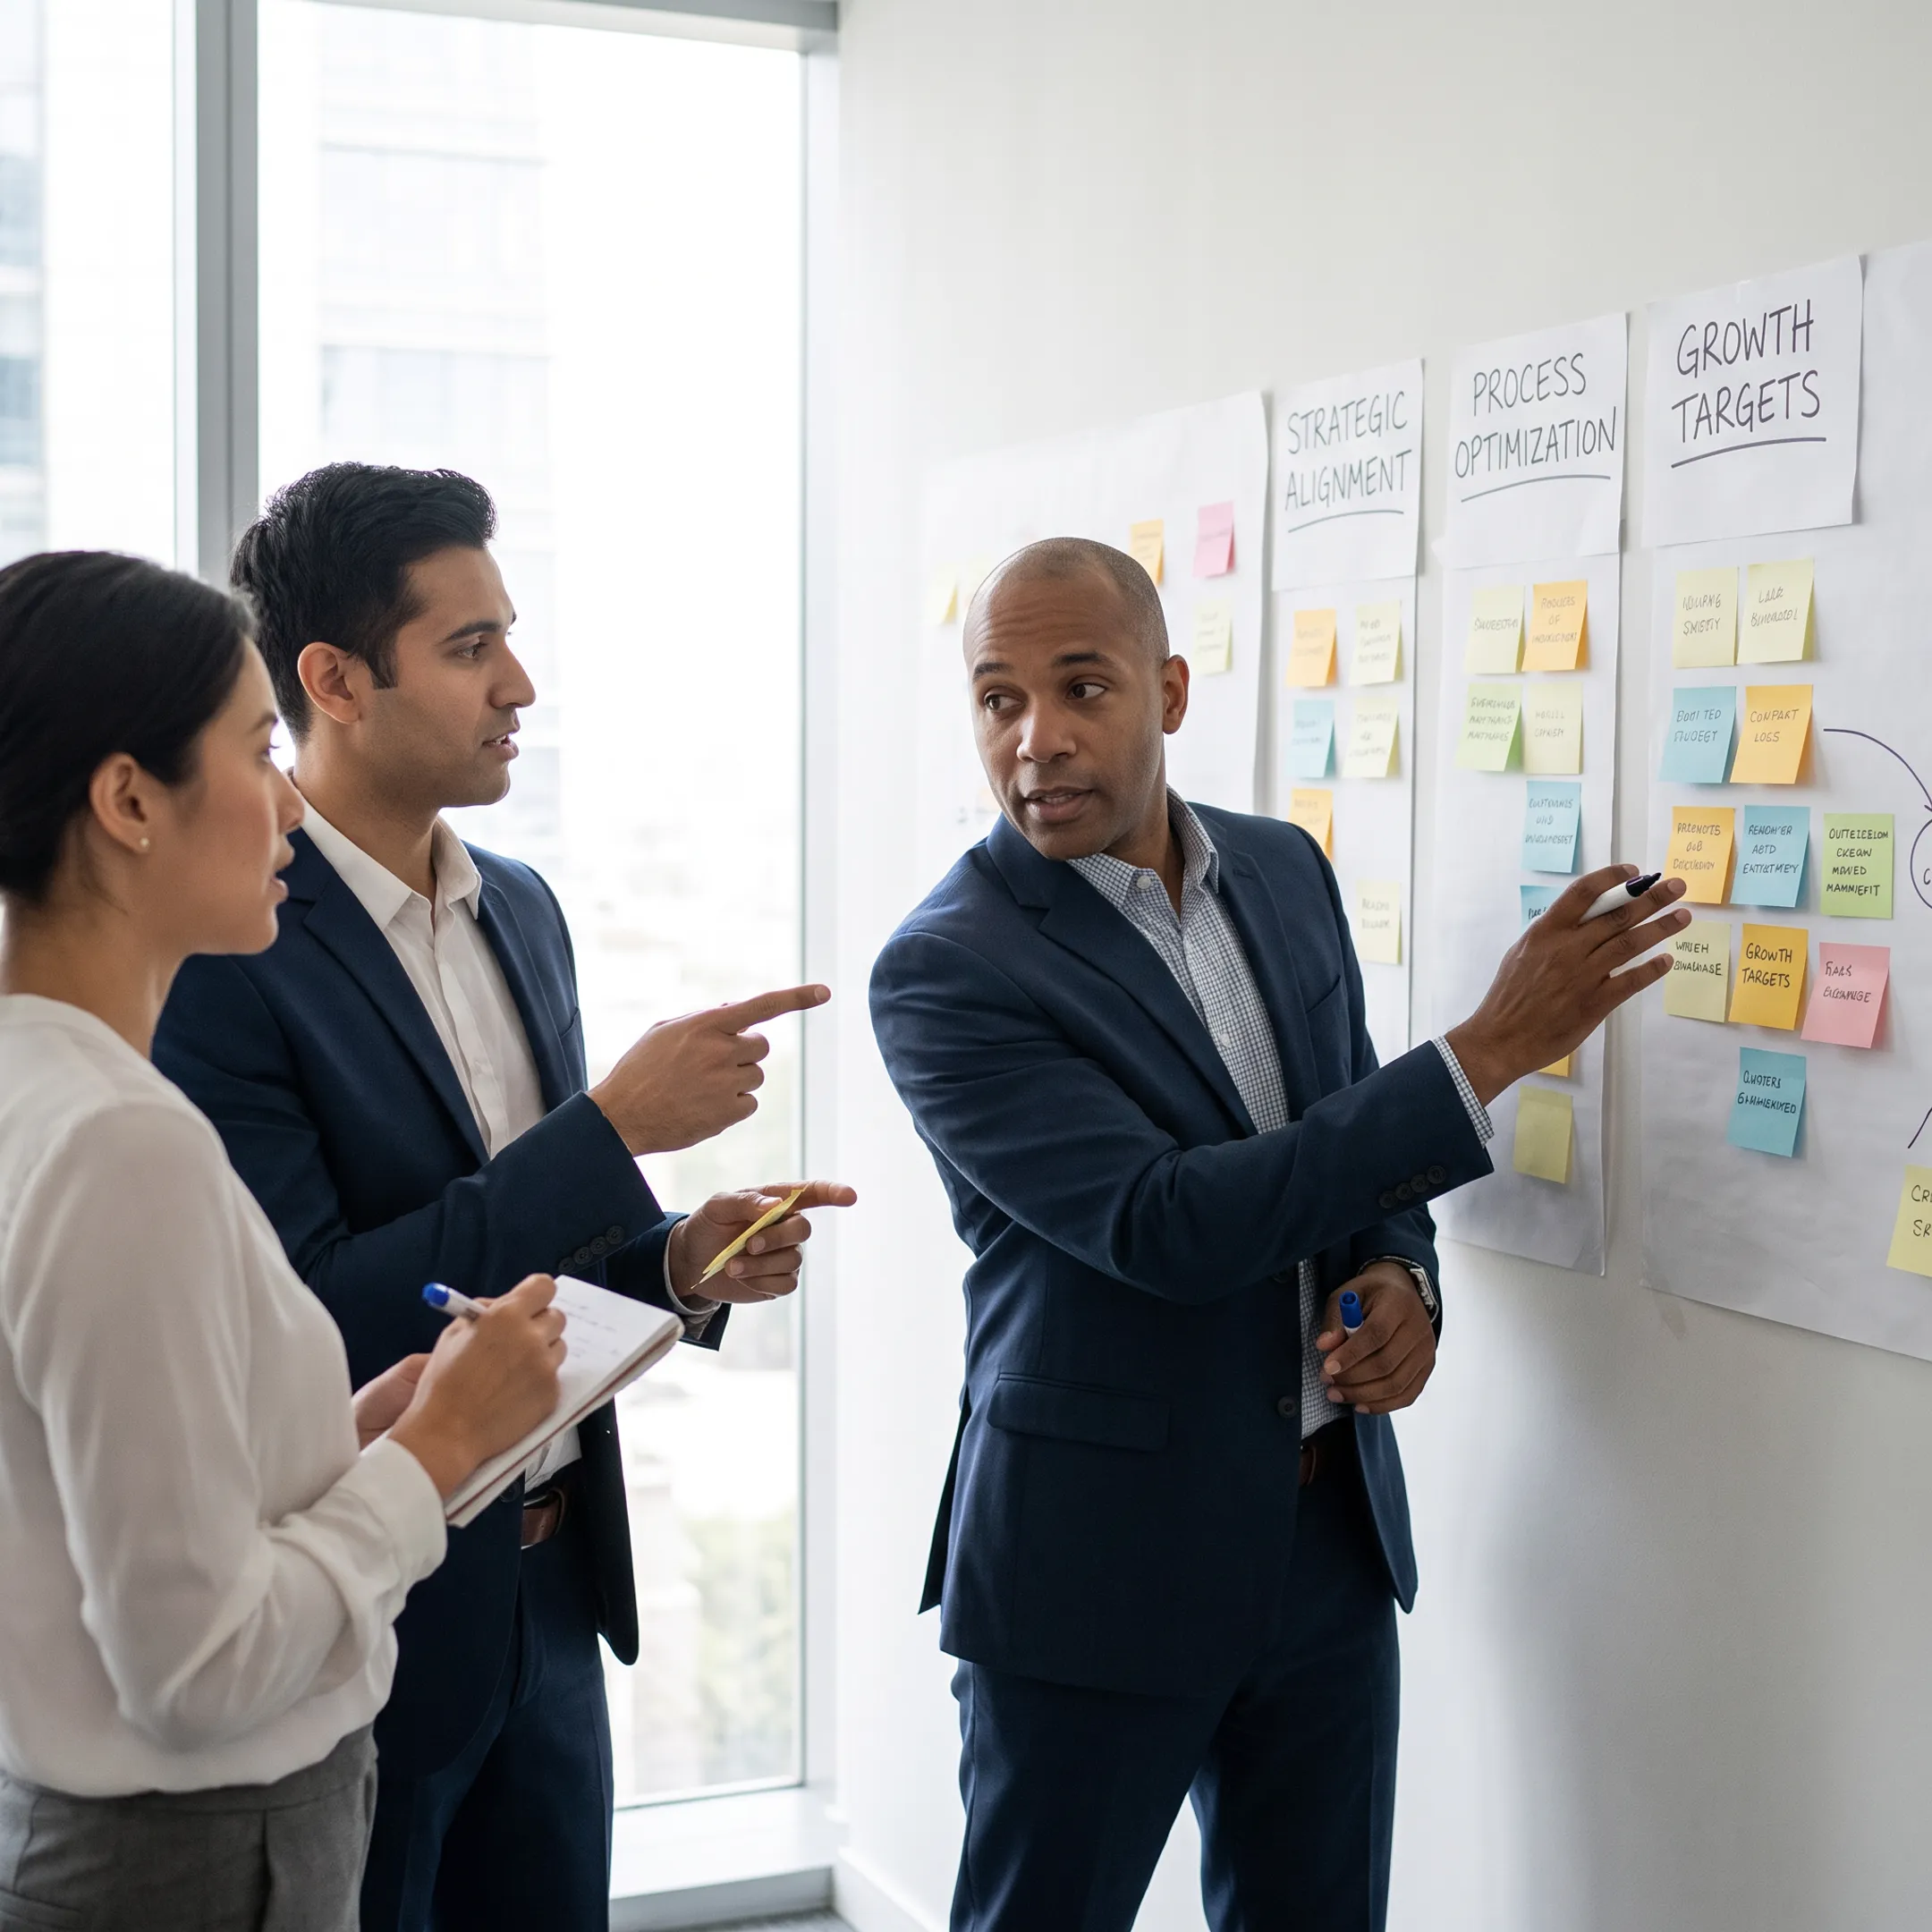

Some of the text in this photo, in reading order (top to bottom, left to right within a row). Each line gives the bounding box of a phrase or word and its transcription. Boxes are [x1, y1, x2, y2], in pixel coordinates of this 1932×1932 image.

[1677, 300, 1814, 377] GROWTH
[1472, 352, 1587, 417] PROCESS
[1672, 369, 1821, 445] TARGETS
[1287, 391, 1408, 454] STRATEGIC
[1454, 406, 1617, 479] OPTIMIZATION
[1284, 449, 1412, 512] ALIGNMENT
[1741, 967, 1792, 988] TARGETS
[1745, 942, 1793, 963] GROWTH
